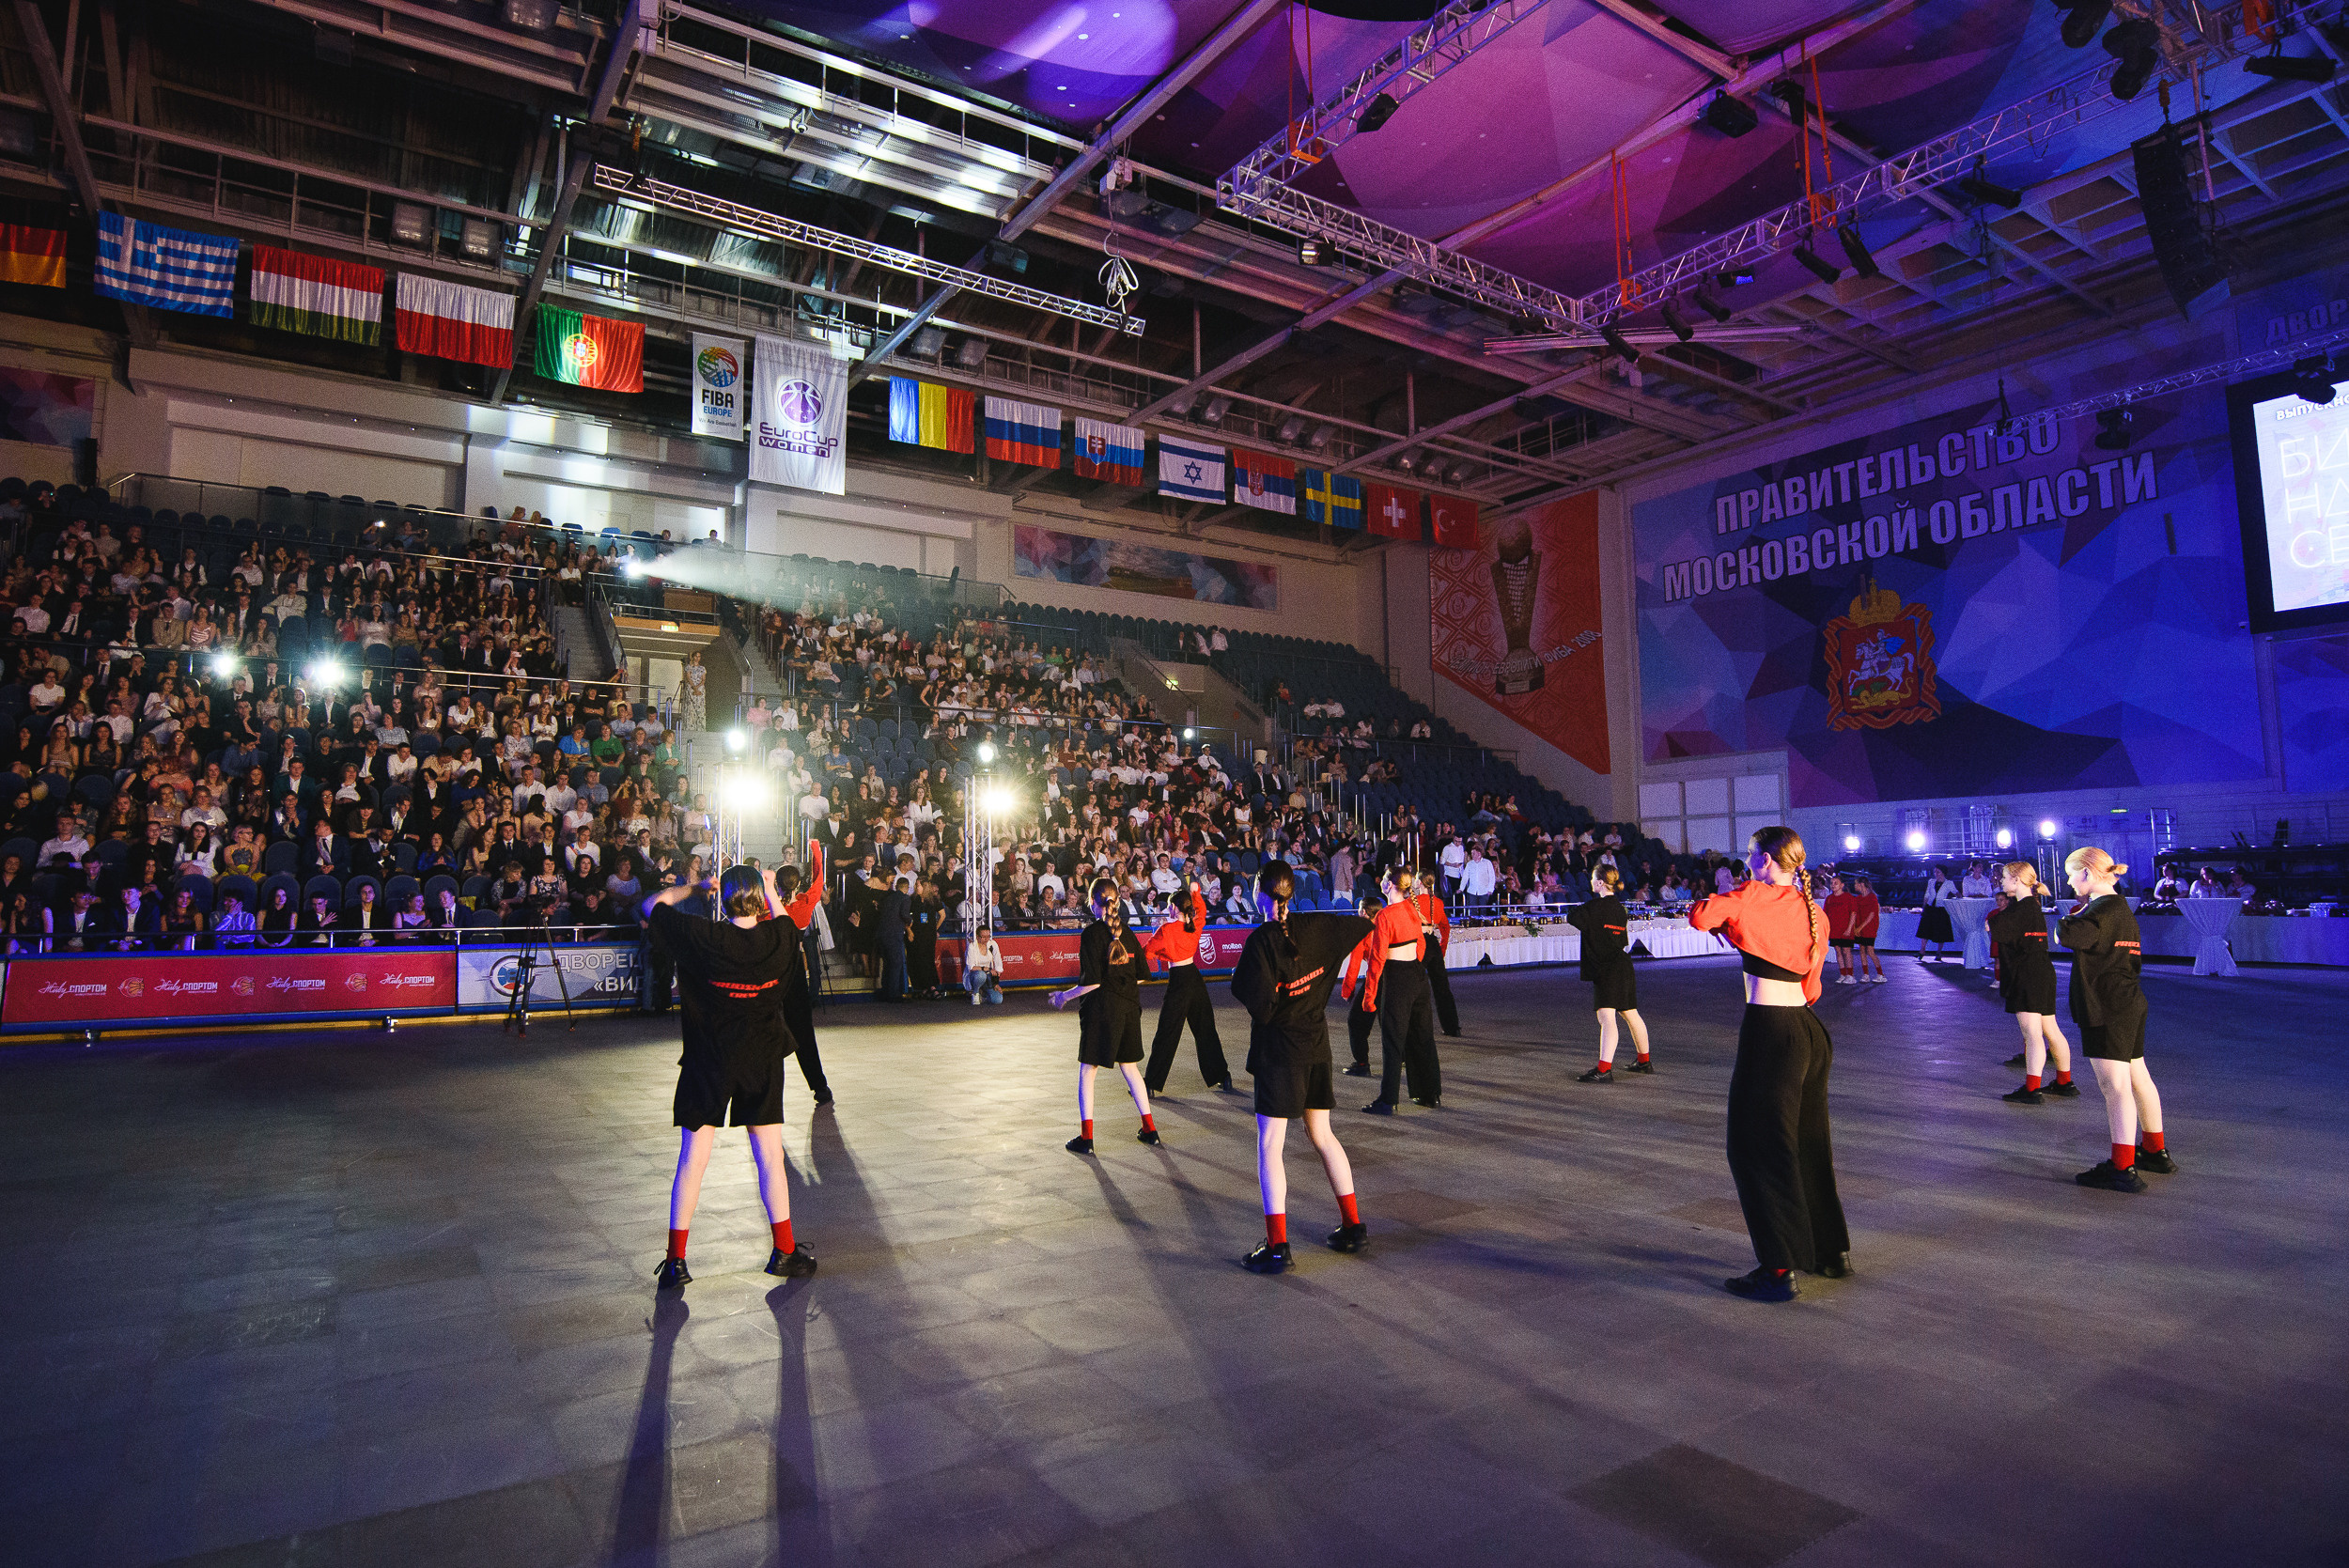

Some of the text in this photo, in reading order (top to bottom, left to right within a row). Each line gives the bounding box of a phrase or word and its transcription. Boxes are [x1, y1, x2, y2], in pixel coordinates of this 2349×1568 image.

[702, 388, 734, 409] FIBA
[703, 406, 732, 418] EUROPE
[760, 437, 830, 458] women
[1716, 413, 2061, 535] ПРАВИТЕЛЬСТВО
[1663, 451, 2159, 602] МОСКОВСКОЙ ОБЛАСТИ
[1450, 629, 1603, 675] ЧЕМПИОН ЕВРОЛИГИ ФИБА 2008
[182, 982, 218, 991] СПОРТОМ
[292, 979, 326, 987] СПОРТОМ
[404, 975, 435, 984] СПОРТОМ
[70, 984, 107, 993] СПОРТОМ
